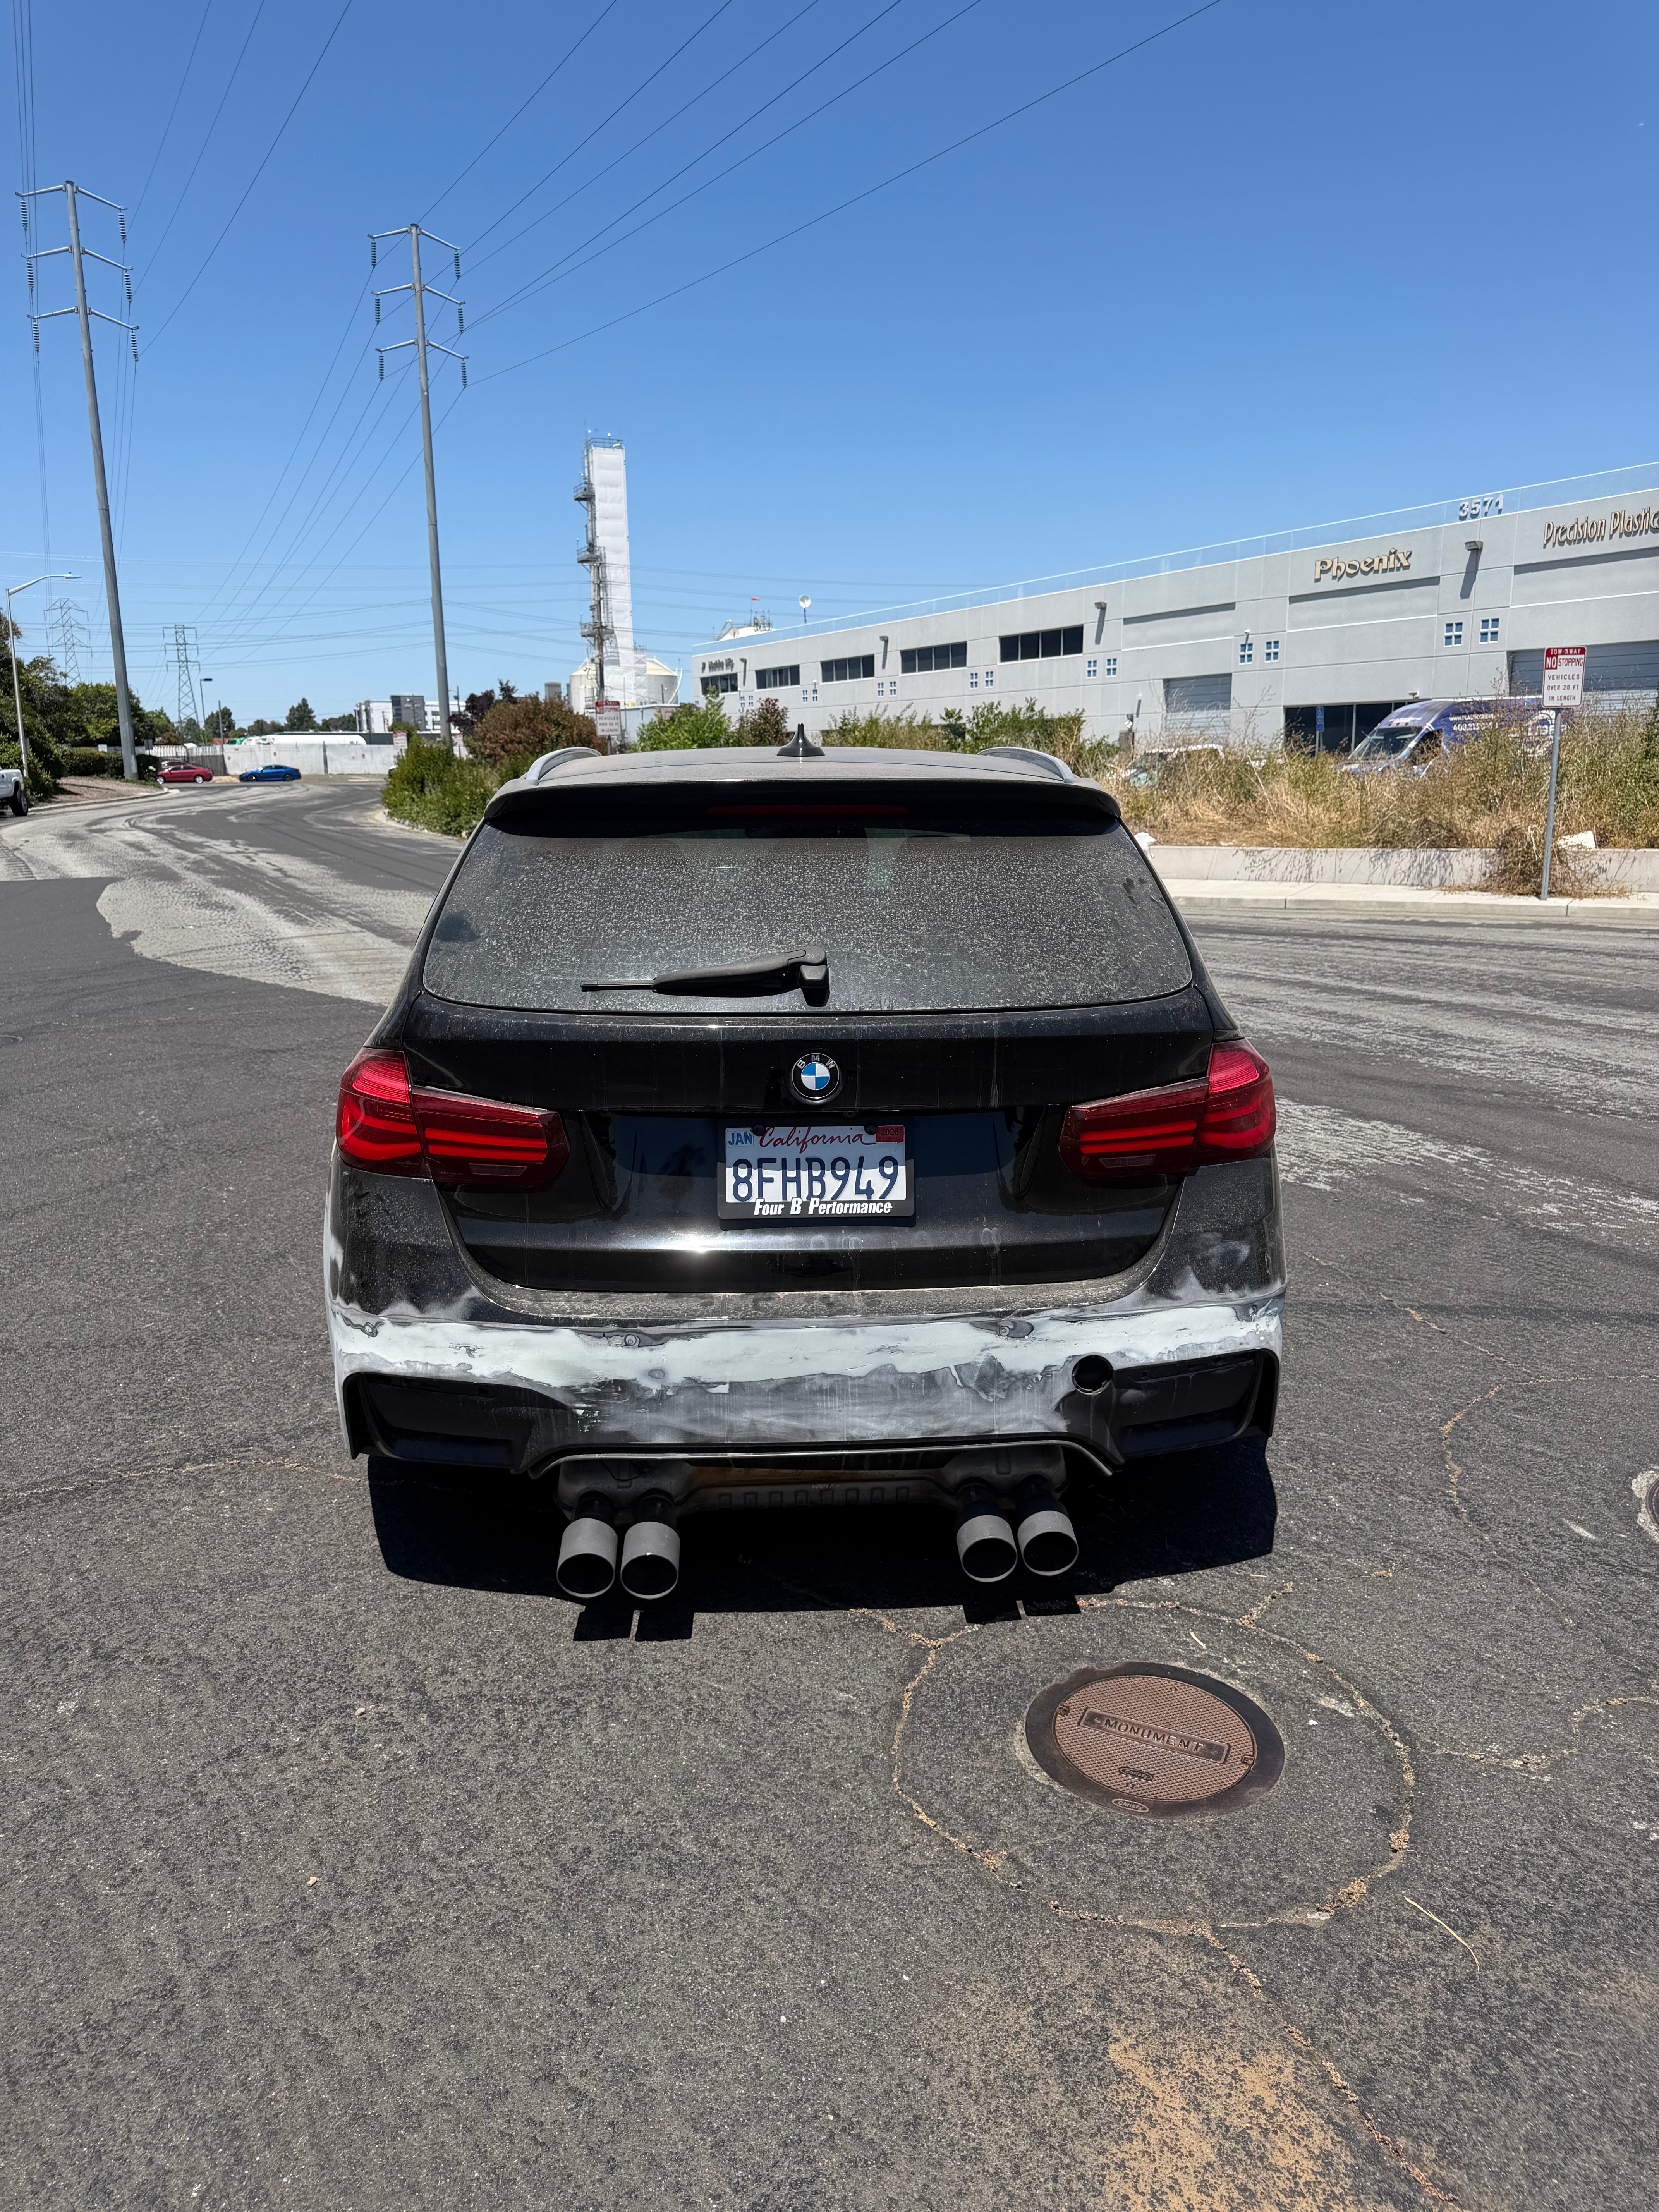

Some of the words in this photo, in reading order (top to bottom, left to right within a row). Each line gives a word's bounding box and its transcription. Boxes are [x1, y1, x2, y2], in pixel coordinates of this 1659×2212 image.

[1458, 494, 1504, 518] 3571
[1543, 516, 1606, 544] Precision
[1314, 547, 1412, 580] Phoenix
[1546, 656, 1557, 668] NO
[1558, 658, 1583, 667] STOPPING
[797, 1054, 835, 1070] BMW
[728, 1132, 753, 1145] JAN
[759, 1126, 876, 1154] California
[732, 1156, 899, 1202] 8FHB949
[754, 1198, 785, 1216] Four
[790, 1197, 803, 1215] B
[808, 1197, 893, 1215] Performance
[1104, 1718, 1206, 1752] MONUMENT
[1118, 1801, 1144, 1810] Christy
